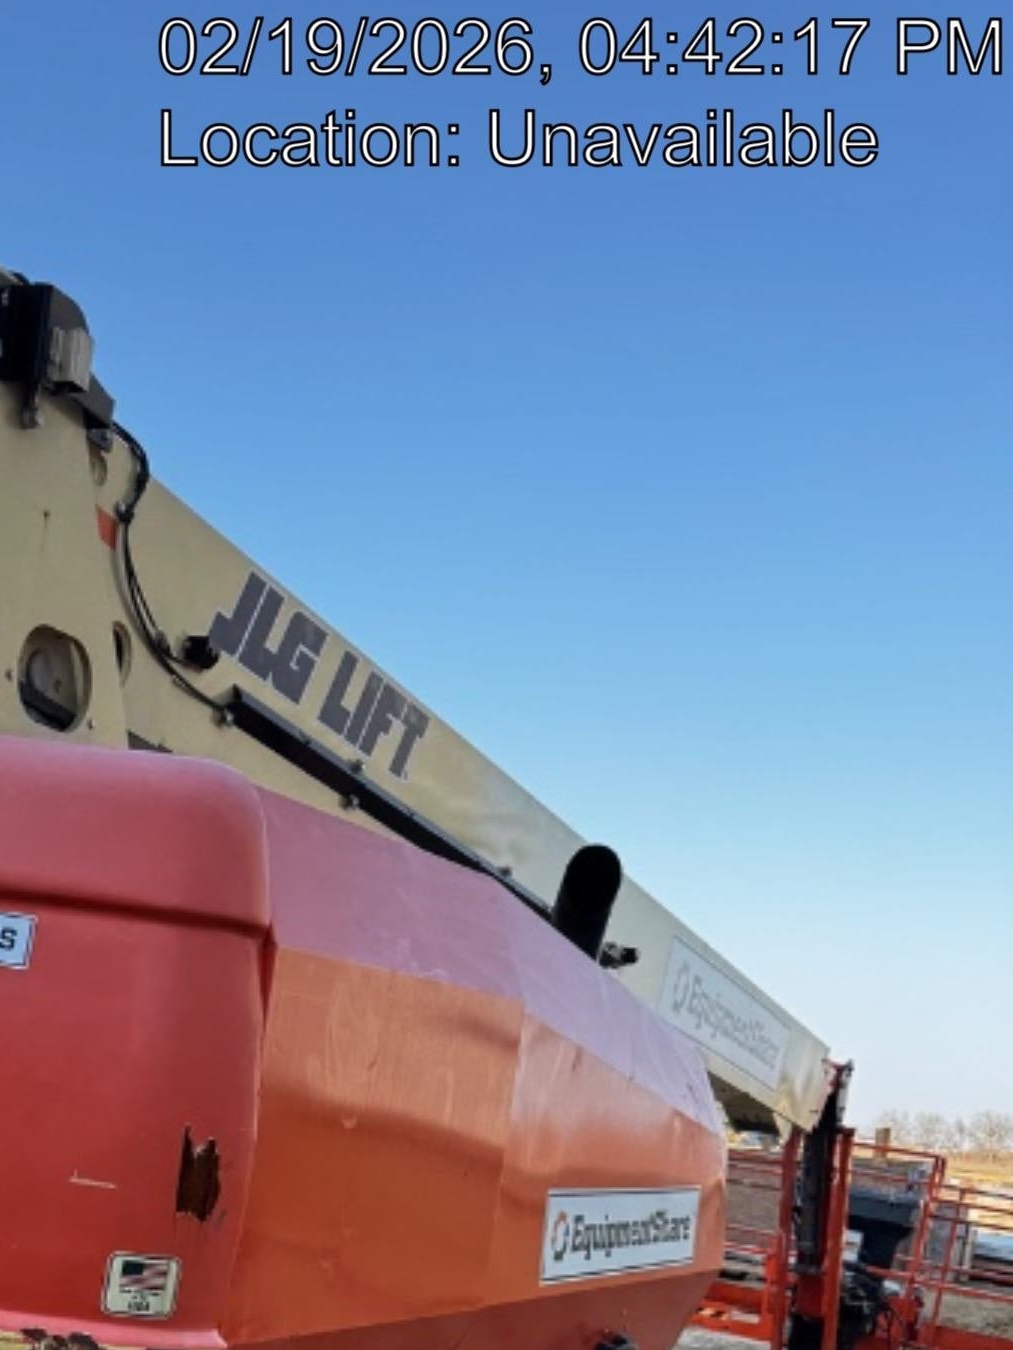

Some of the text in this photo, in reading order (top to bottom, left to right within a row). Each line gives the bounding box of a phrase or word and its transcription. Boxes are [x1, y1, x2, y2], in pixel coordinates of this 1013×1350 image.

[208, 571, 431, 777] JLG LIFT
[570, 1210, 691, 1261] EquipmentShare
